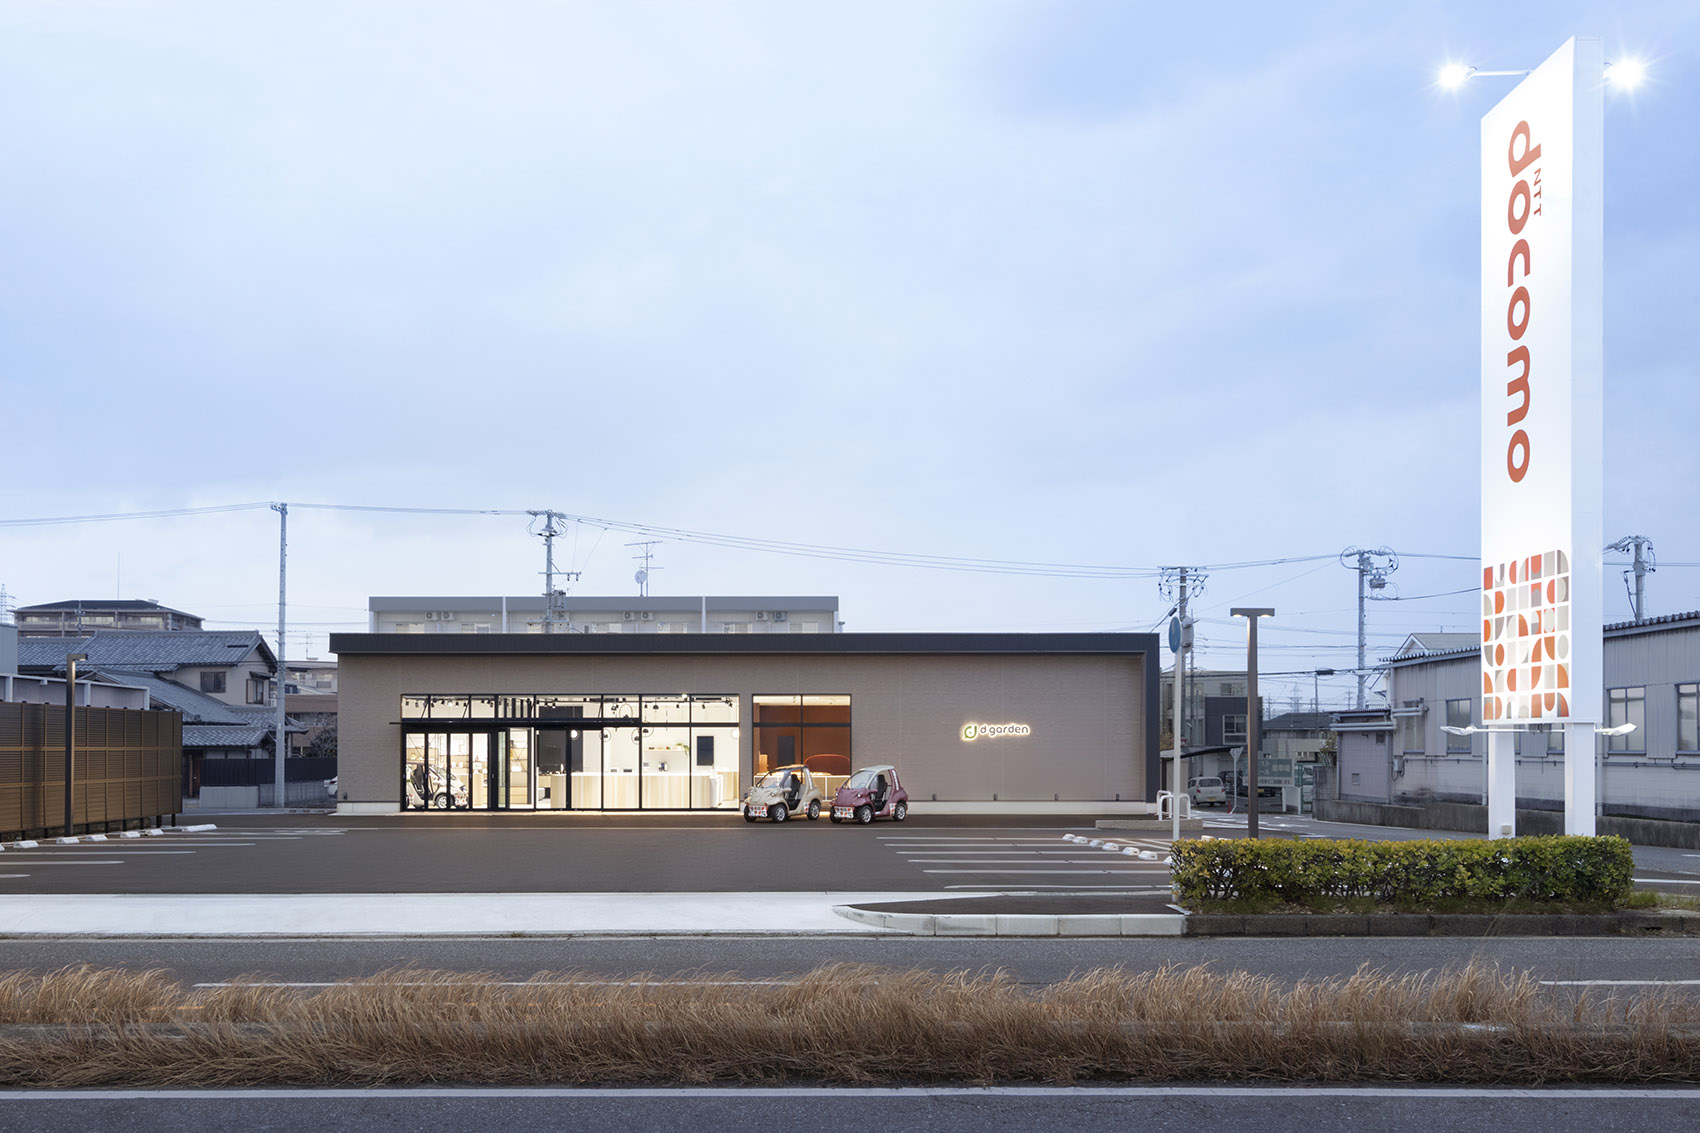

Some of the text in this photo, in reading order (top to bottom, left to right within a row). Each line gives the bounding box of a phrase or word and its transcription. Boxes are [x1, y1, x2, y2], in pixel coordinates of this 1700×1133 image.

[1533, 168, 1541, 216] NTT
[1508, 120, 1541, 483] docomo
[980, 725, 1029, 736] d garden
